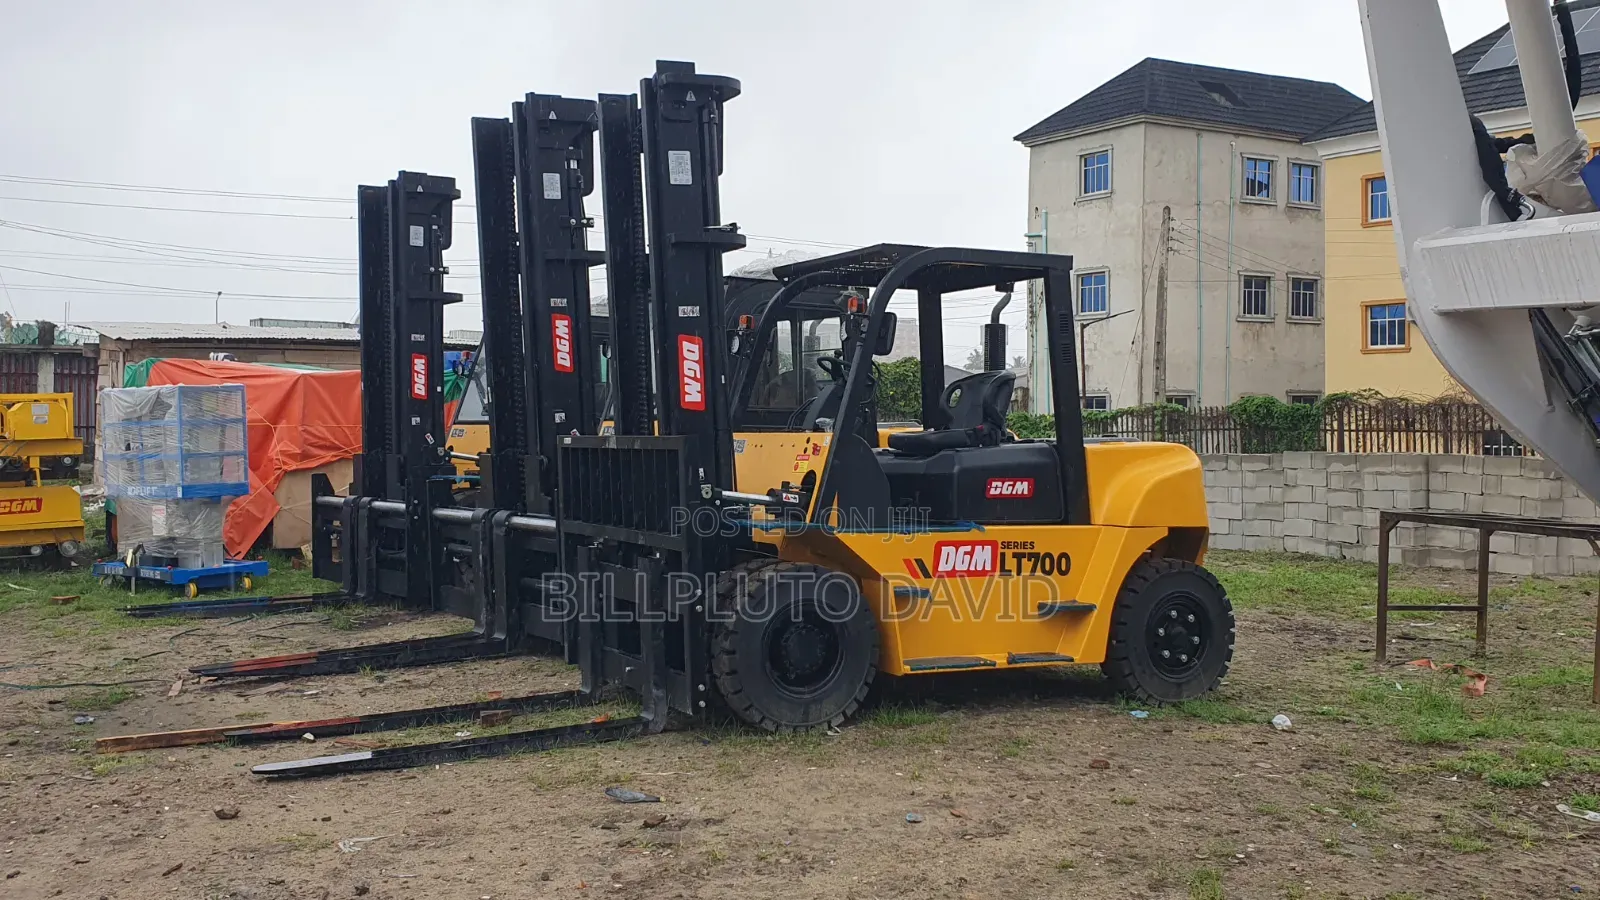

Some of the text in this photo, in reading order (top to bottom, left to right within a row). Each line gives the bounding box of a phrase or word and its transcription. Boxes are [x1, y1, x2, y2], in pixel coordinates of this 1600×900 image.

[556, 319, 571, 367] DGM
[414, 358, 426, 396] DGM
[683, 341, 702, 402] DGM
[989, 481, 1029, 495] DGM
[937, 545, 992, 572] DGM
[1000, 541, 1035, 550] SERIES
[1000, 552, 1072, 577] LT700
